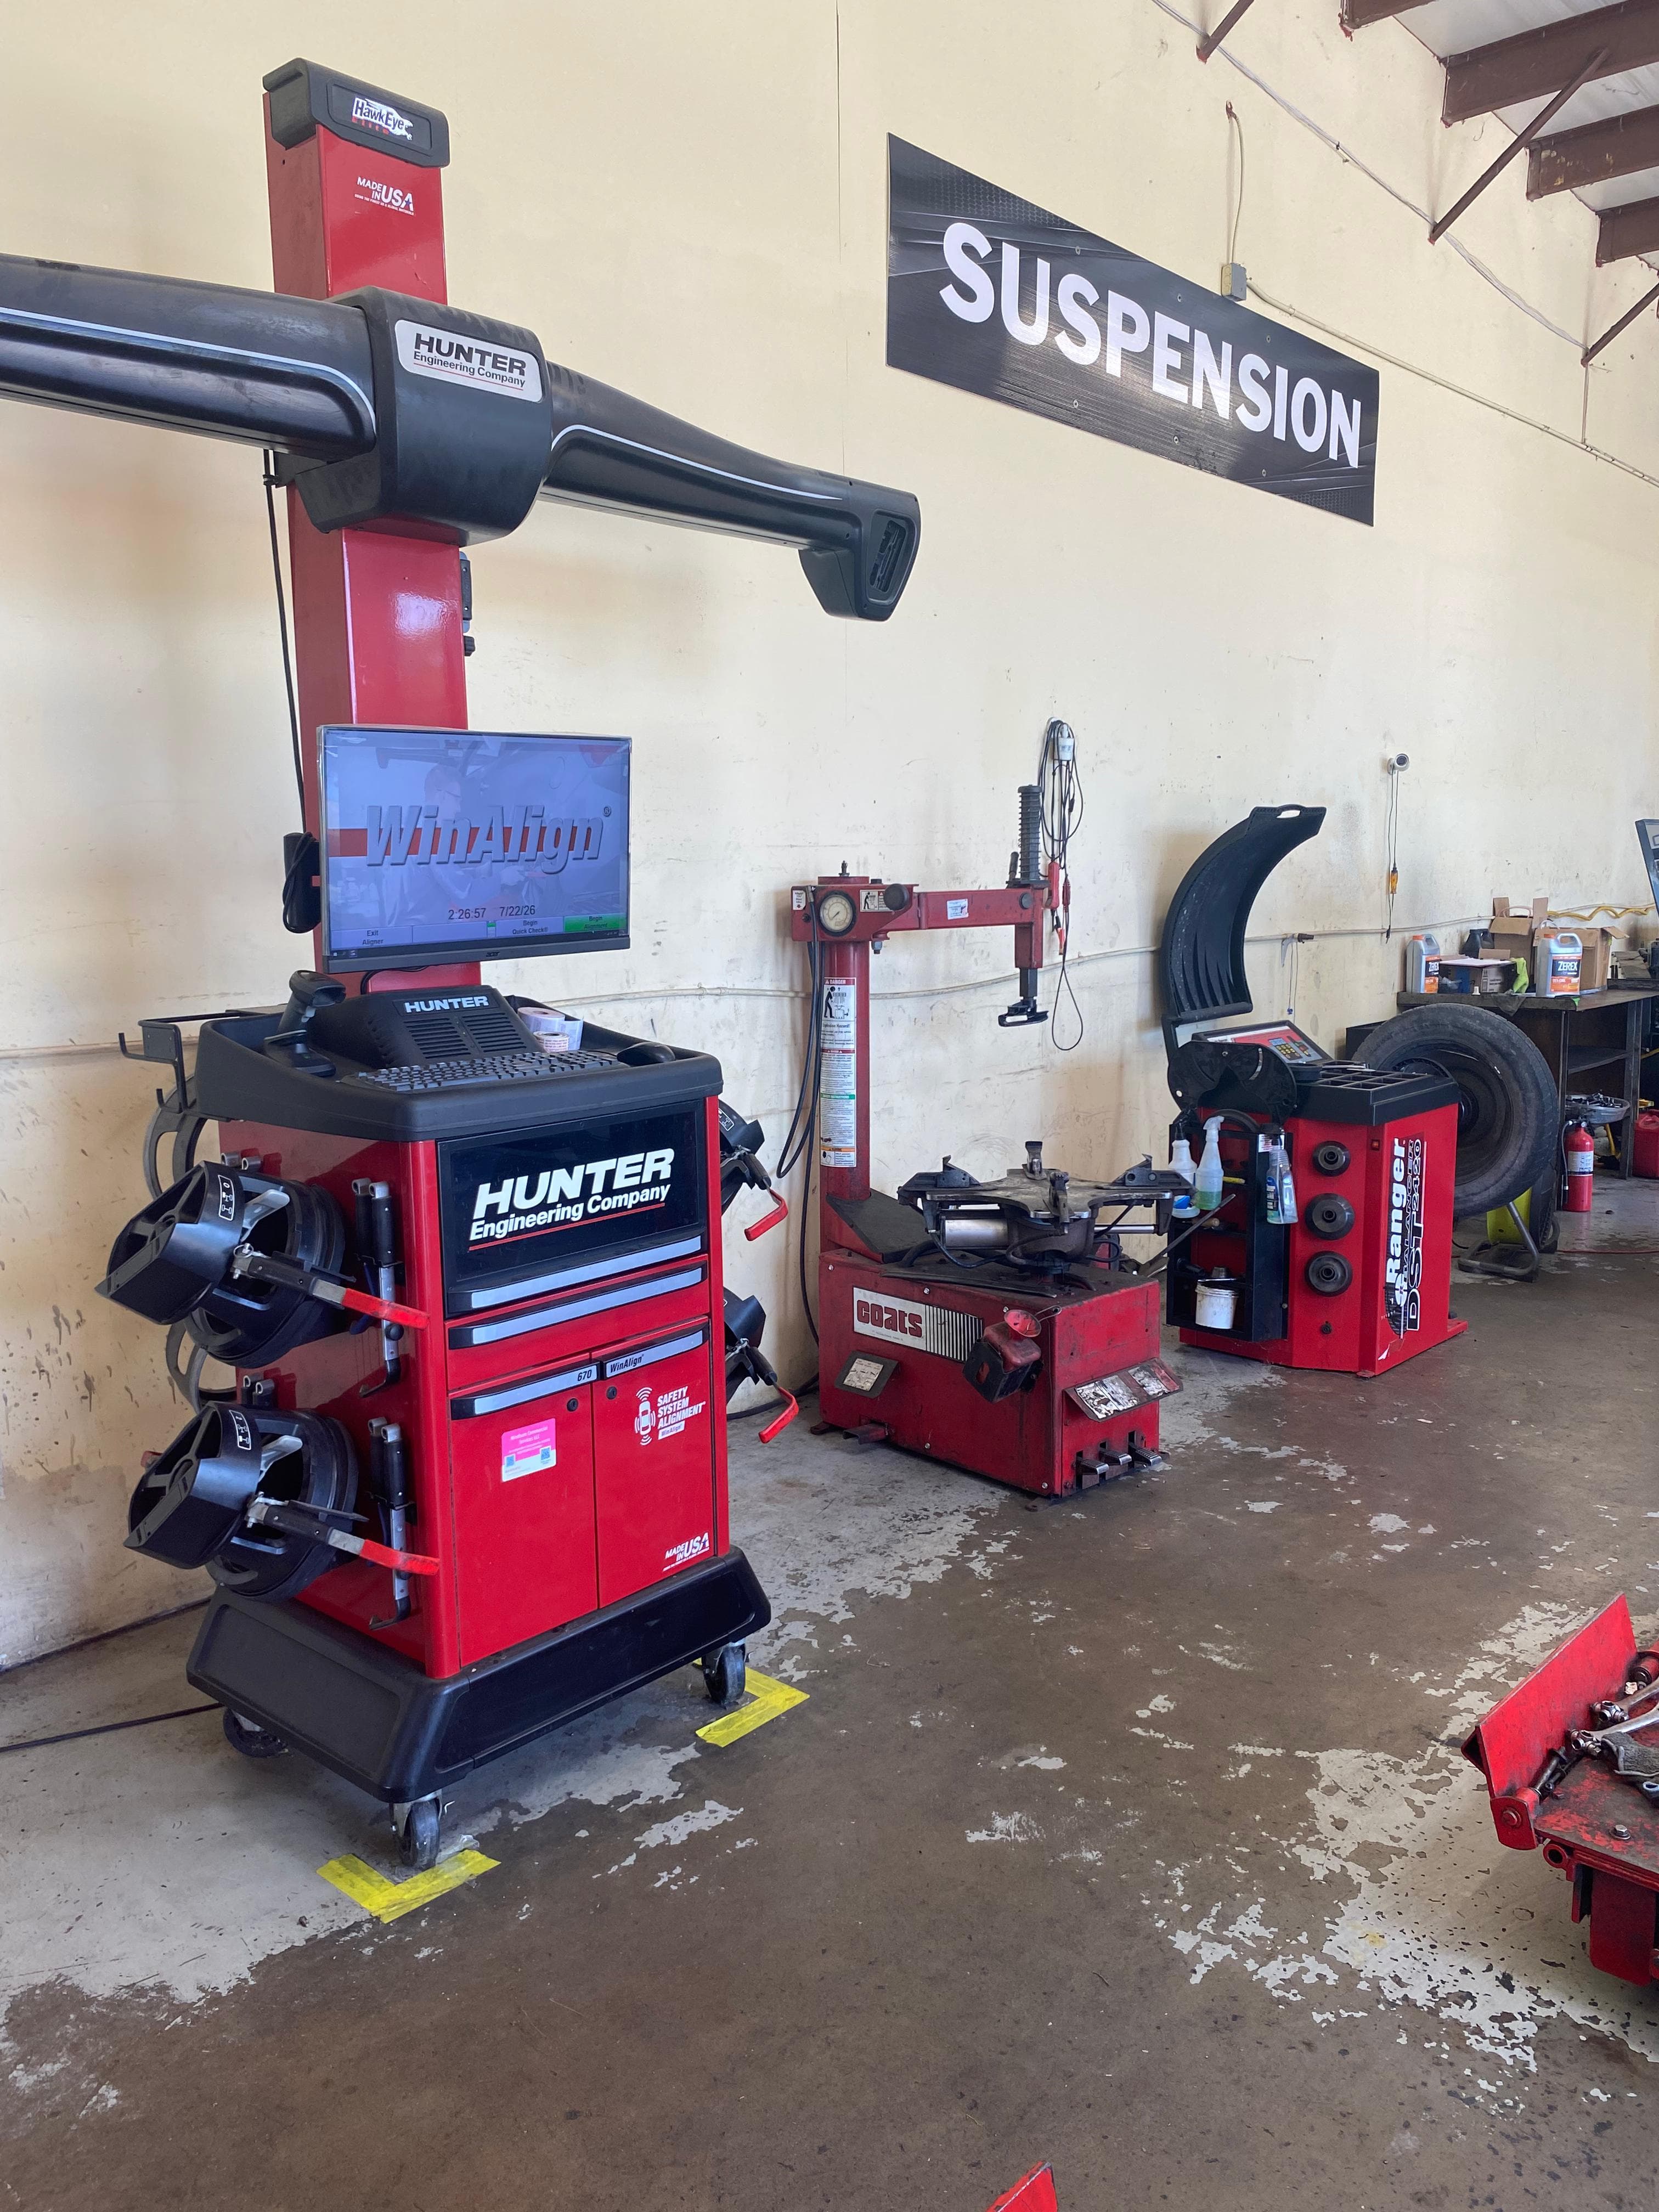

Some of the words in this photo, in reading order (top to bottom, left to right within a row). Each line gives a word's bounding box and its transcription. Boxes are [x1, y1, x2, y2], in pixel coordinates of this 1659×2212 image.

[354, 100, 405, 130] HawkEye
[357, 176, 383, 192] MADE
[372, 190, 381, 201] IN
[381, 184, 414, 212] USA
[414, 332, 527, 376] HUNTER
[939, 222, 1362, 469] SUSPENSION
[414, 351, 475, 376] Engineering
[477, 367, 526, 387] Company
[448, 907, 486, 920] 2:26:57
[499, 905, 535, 917] 7/22/26
[1558, 961, 1578, 971] ZEREX
[404, 995, 489, 1013] HUNTER
[473, 1148, 675, 1220] HUNTER
[469, 1203, 584, 1241] Engineering
[587, 1184, 672, 1214] Company
[1386, 1138, 1407, 1283] Ranger
[1403, 1139, 1414, 1283] BALANCER
[577, 1369, 592, 1381] 670
[657, 1386, 688, 1407] SAFETY
[658, 1396, 690, 1418] SYSTEM
[665, 1543, 685, 1559] MADE
[676, 1551, 684, 1562] IN
[684, 1532, 709, 1557] USA
